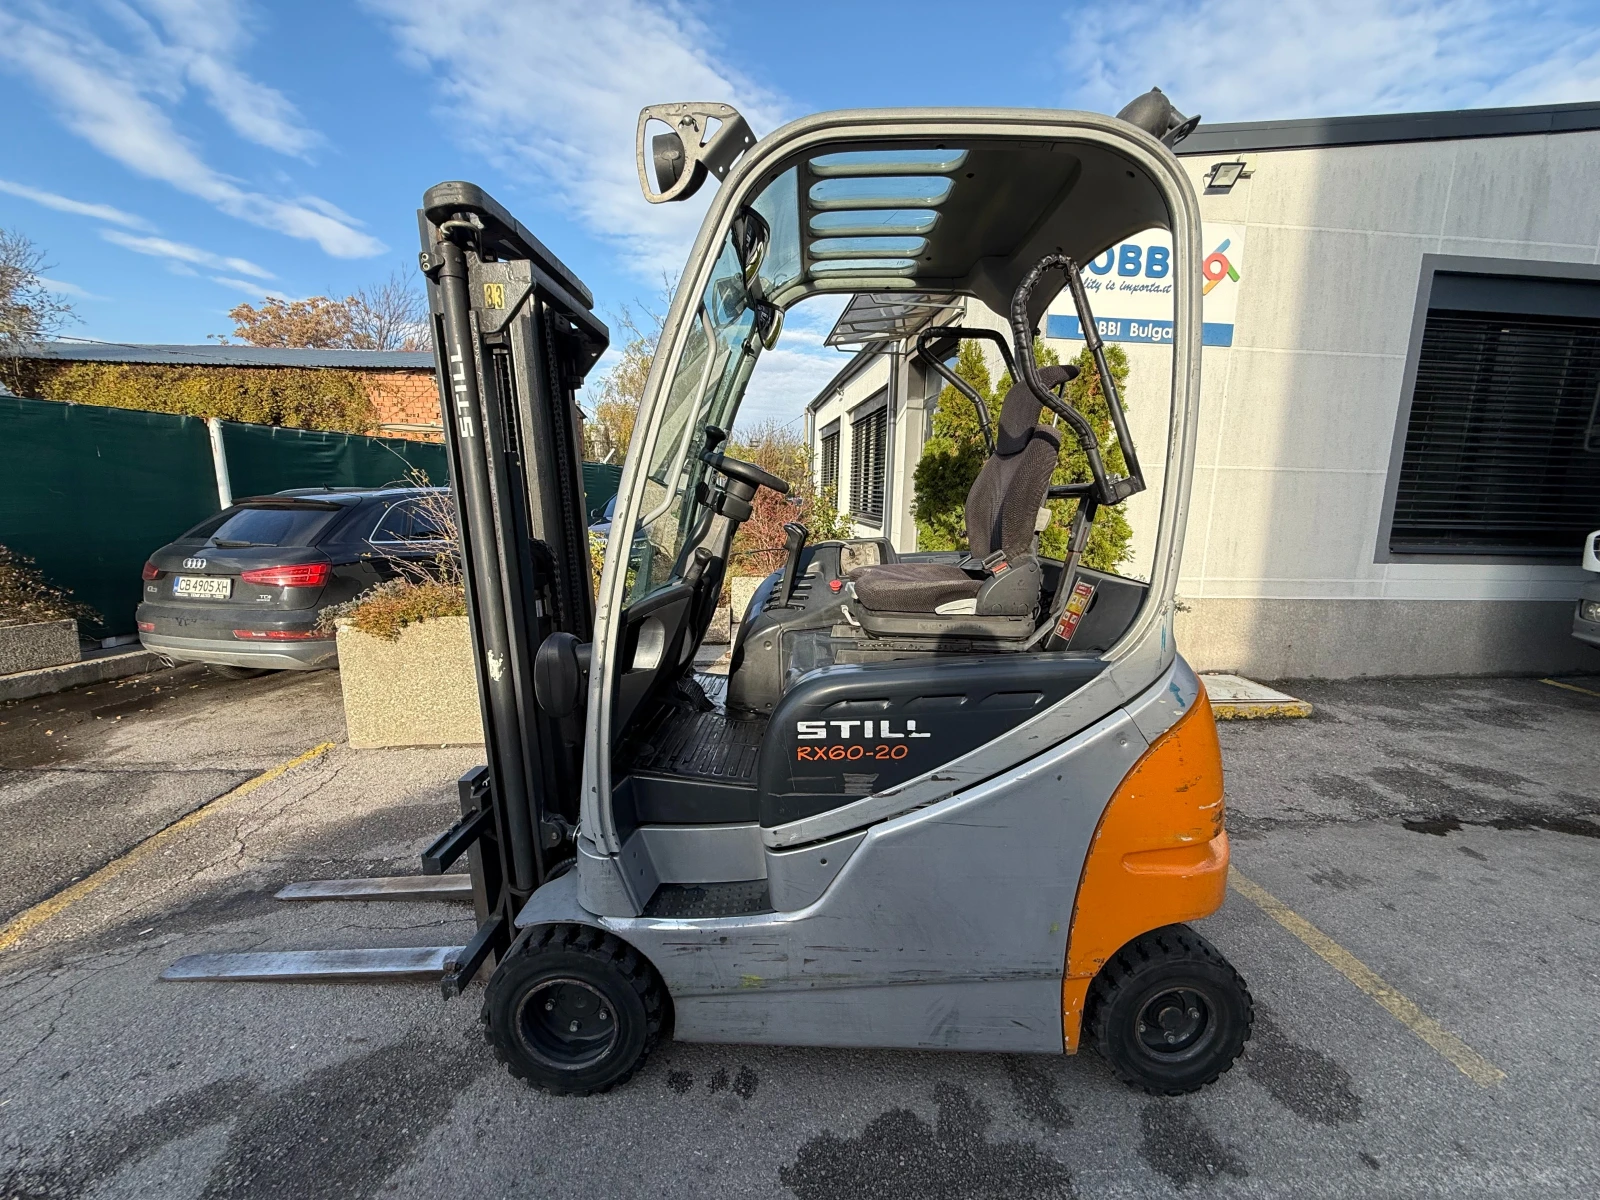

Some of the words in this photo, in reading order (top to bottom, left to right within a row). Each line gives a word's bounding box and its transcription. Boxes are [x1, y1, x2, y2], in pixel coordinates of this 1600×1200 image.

[1080, 244, 1173, 279] OBB
[1105, 279, 1116, 291] is
[1077, 320, 1121, 337] BBI
[1129, 322, 1173, 341] Bulga
[451, 344, 474, 438] STILL
[179, 579, 191, 591] CB
[192, 580, 214, 592] 4905
[215, 581, 228, 593] XH
[797, 720, 931, 739] STILL
[797, 744, 909, 761] RX60-20
